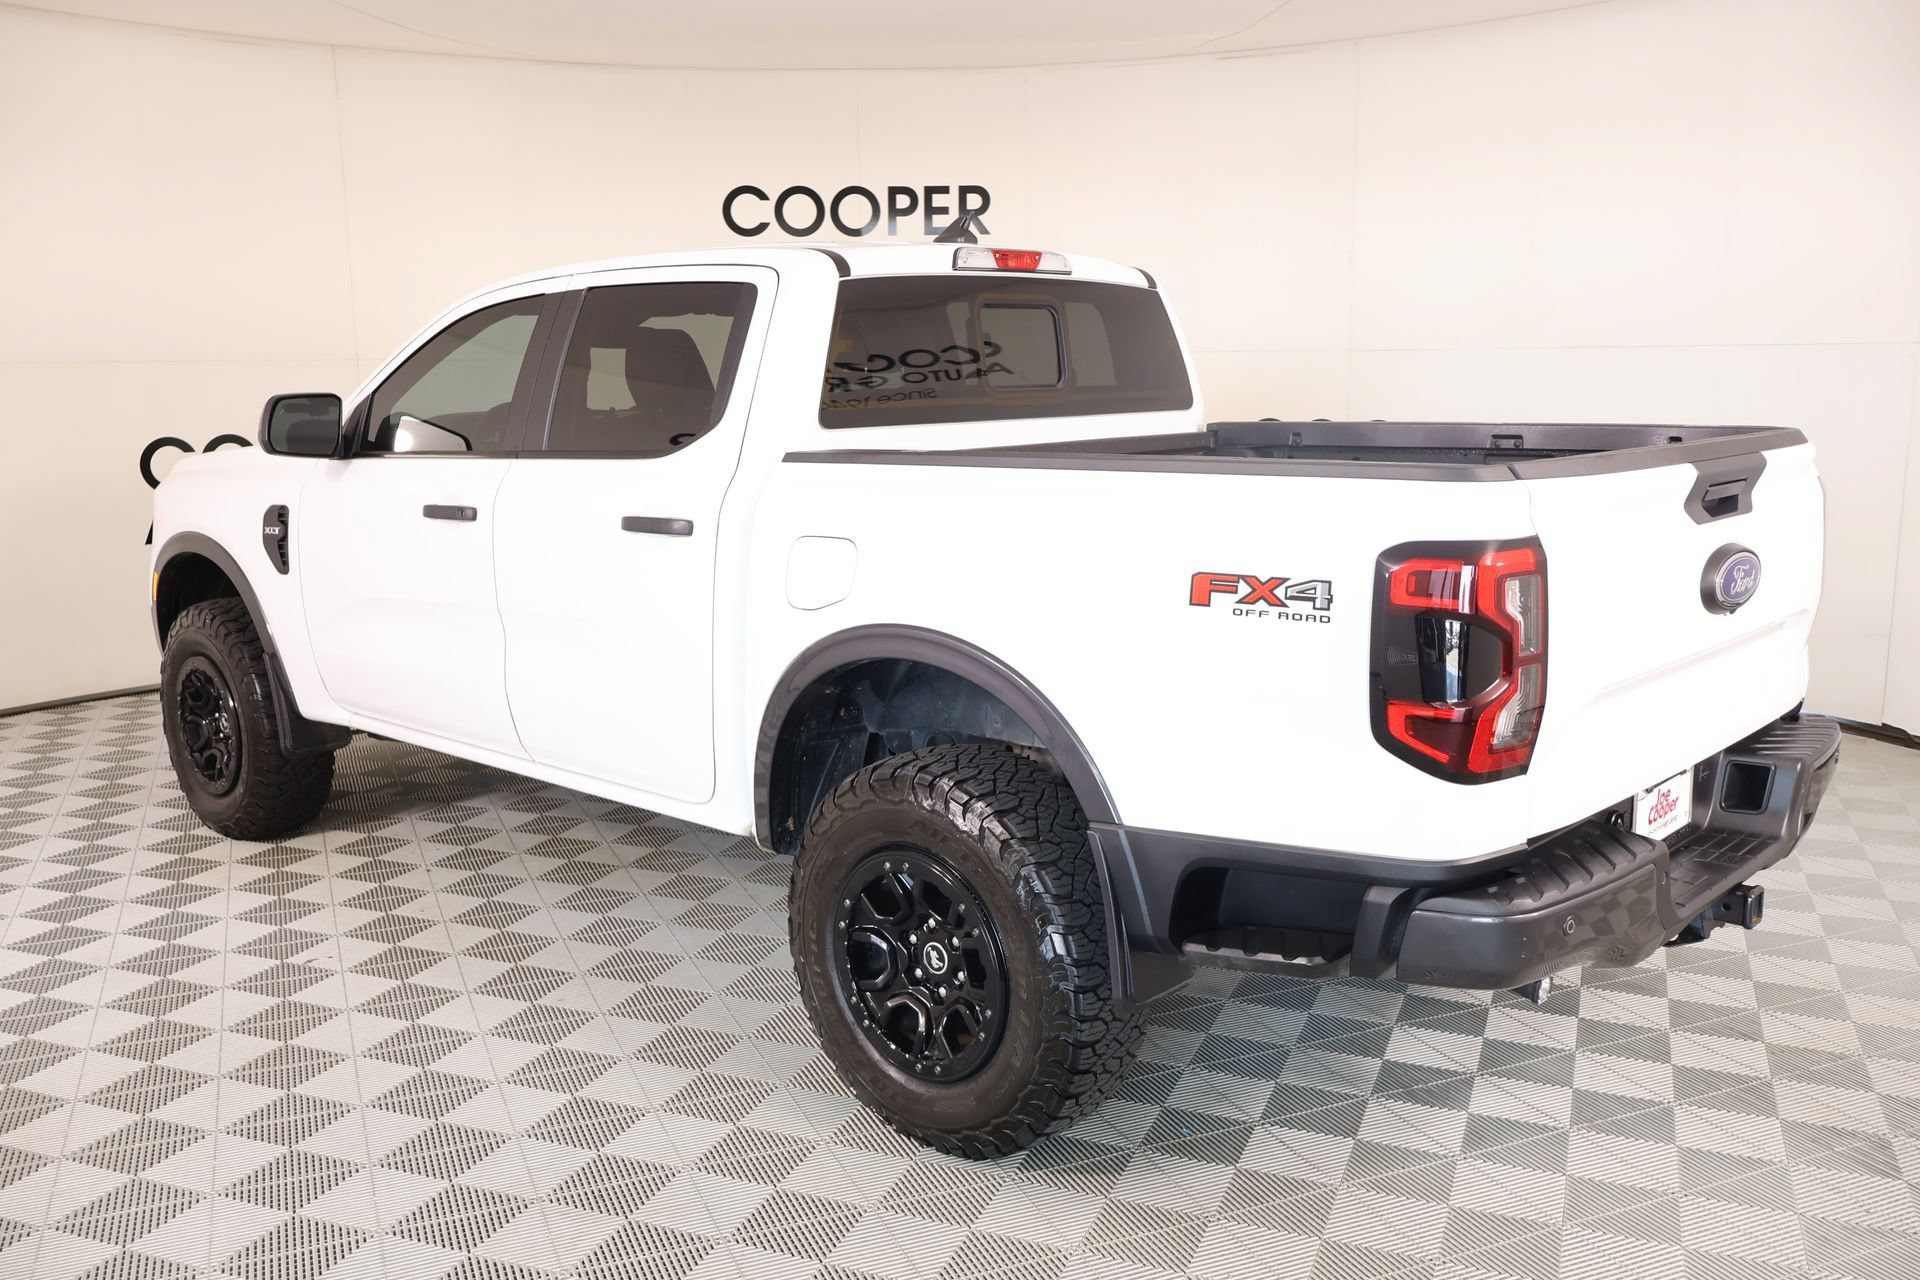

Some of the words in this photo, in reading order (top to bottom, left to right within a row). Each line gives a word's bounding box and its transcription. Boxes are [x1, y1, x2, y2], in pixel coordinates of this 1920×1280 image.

[722, 184, 991, 237] COOPER
[264, 526, 281, 535] XLT
[1189, 571, 1333, 611] FX4
[1730, 564, 1755, 595] Ford
[1232, 608, 1270, 618] OFF
[1278, 611, 1331, 624] ROAD
[1655, 788, 1671, 809] Joe
